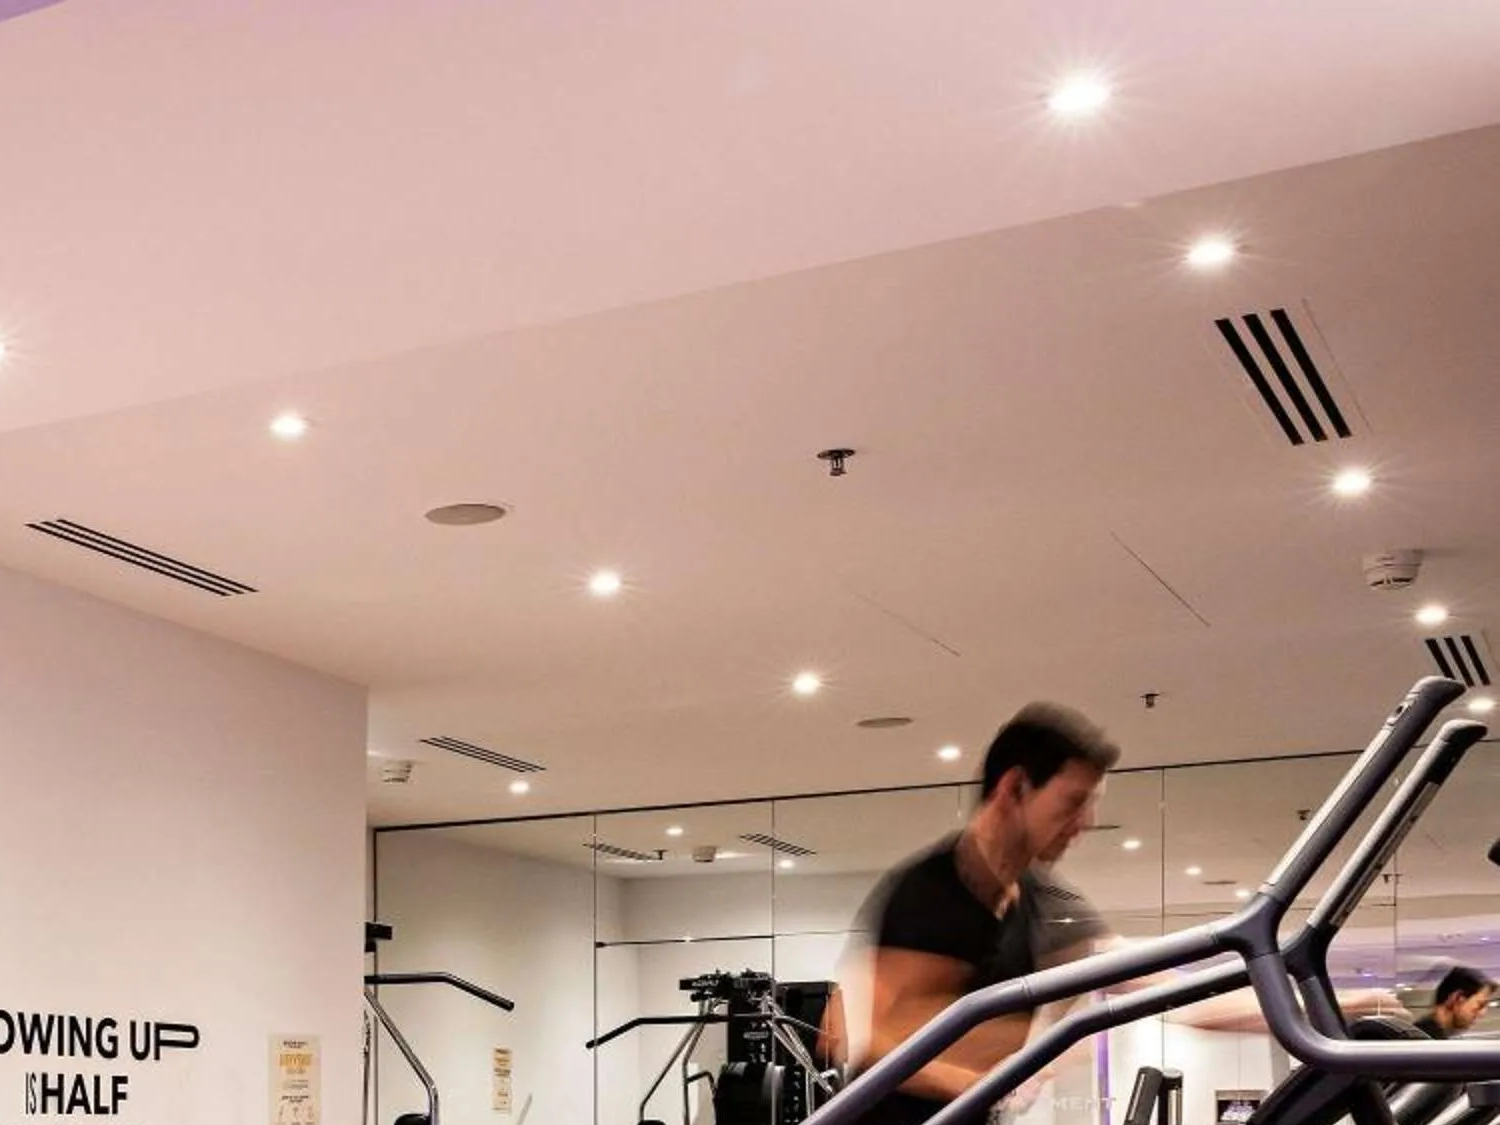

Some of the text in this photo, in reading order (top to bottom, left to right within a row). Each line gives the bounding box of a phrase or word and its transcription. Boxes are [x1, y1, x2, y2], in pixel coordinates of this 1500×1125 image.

[130, 1021, 201, 1061] UP
[25, 1072, 129, 1115] IS HALF
